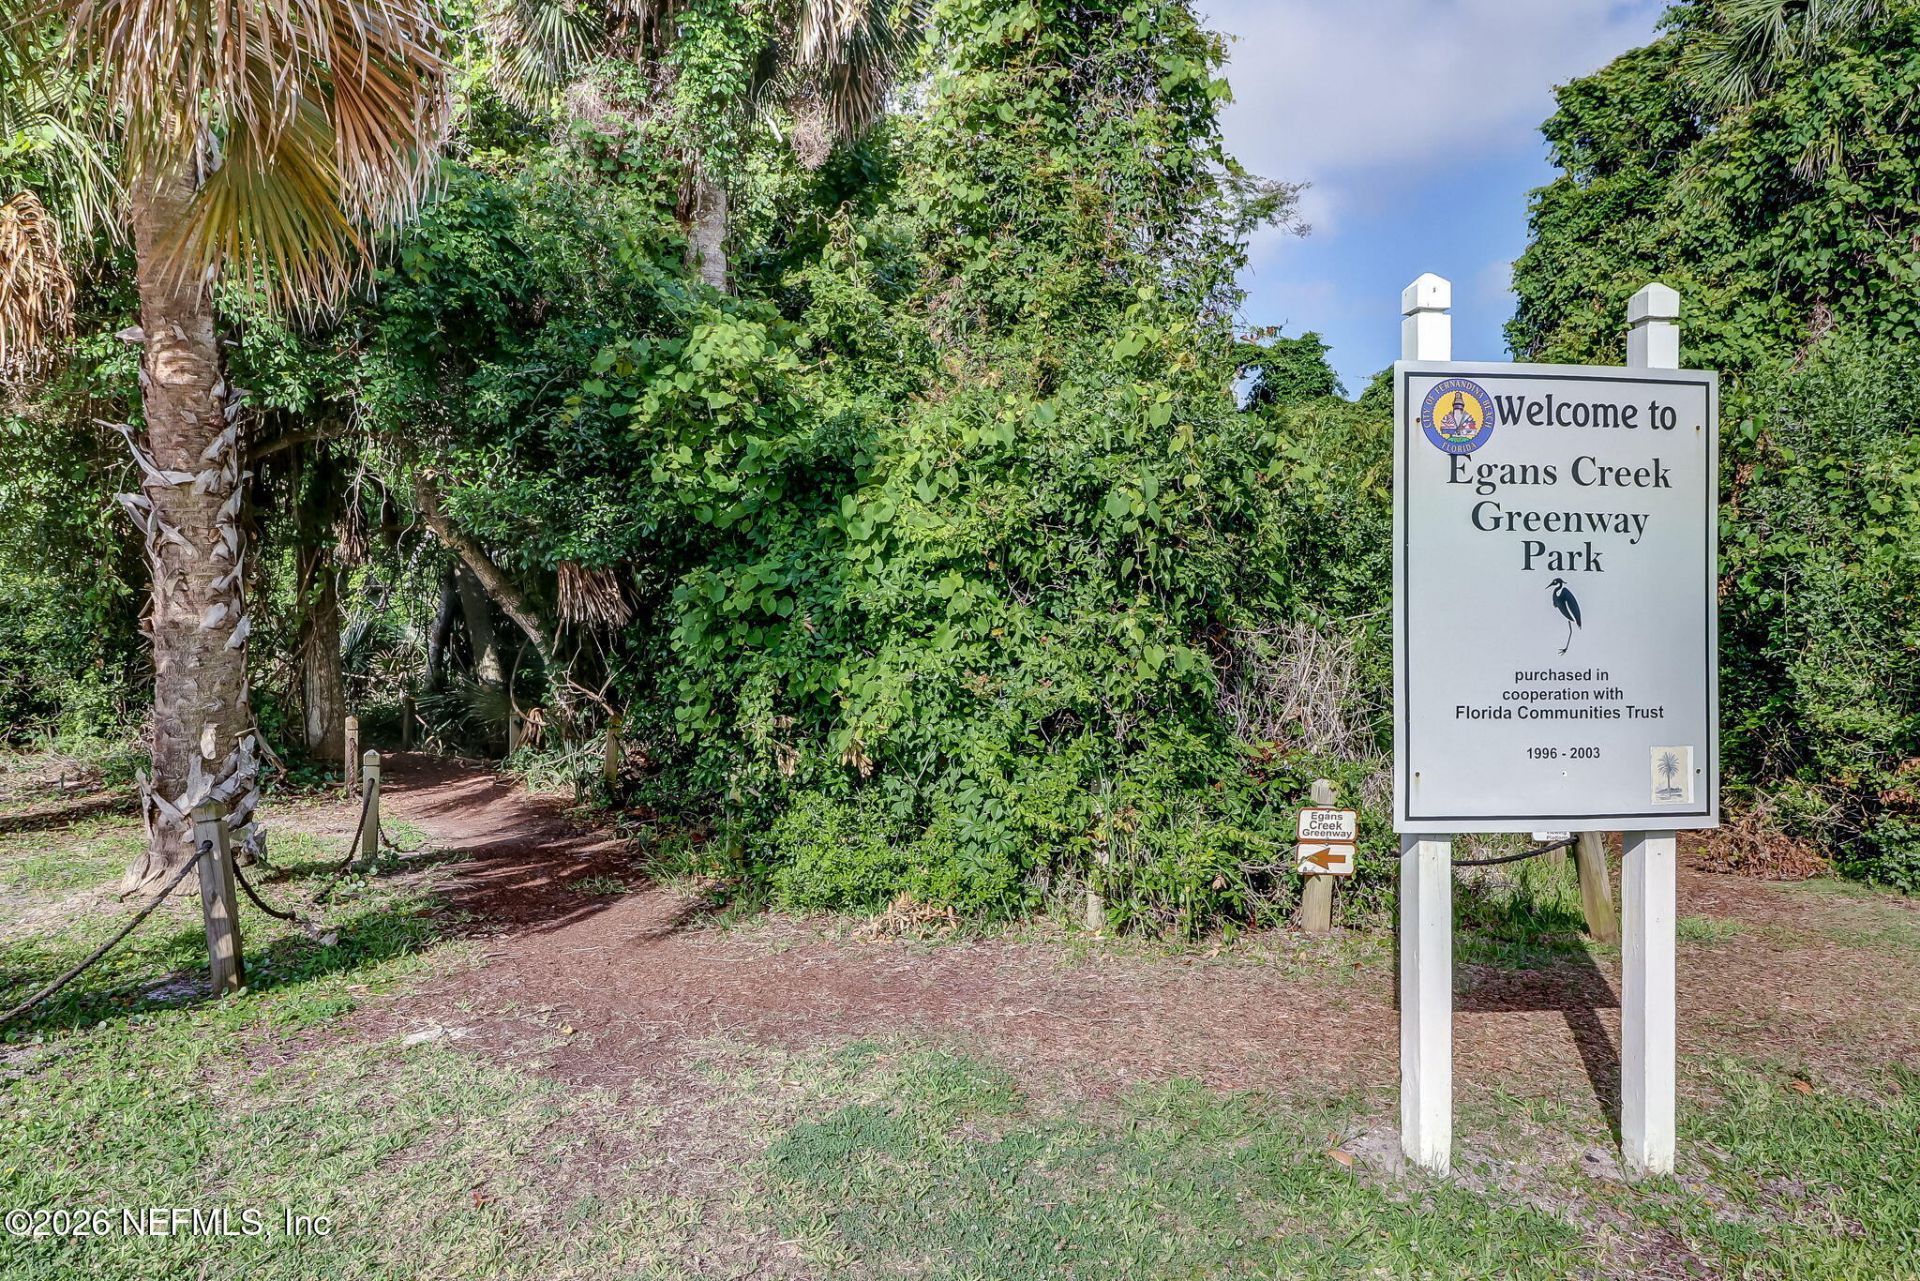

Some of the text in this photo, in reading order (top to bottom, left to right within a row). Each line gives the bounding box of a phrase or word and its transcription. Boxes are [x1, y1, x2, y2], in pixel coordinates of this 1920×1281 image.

[1423, 380, 1492, 428] CITY OF FERNANDINA BEACH
[1494, 393, 1677, 431] Welcome to
[1442, 442, 1476, 452] FLORIDA
[1447, 453, 1672, 495] Egans Creek
[1471, 500, 1651, 545] Greenway
[1521, 540, 1605, 572] Park
[1515, 668, 1609, 684] purchased in
[1502, 687, 1624, 704] cooperation with
[1455, 705, 1664, 719] Florida Communities Trust
[1526, 747, 1558, 760] 1996
[1570, 747, 1600, 759] 2003
[1311, 812, 1343, 821] Egans
[1303, 829, 1352, 838] Greenway
[1310, 821, 1343, 830] Creek
